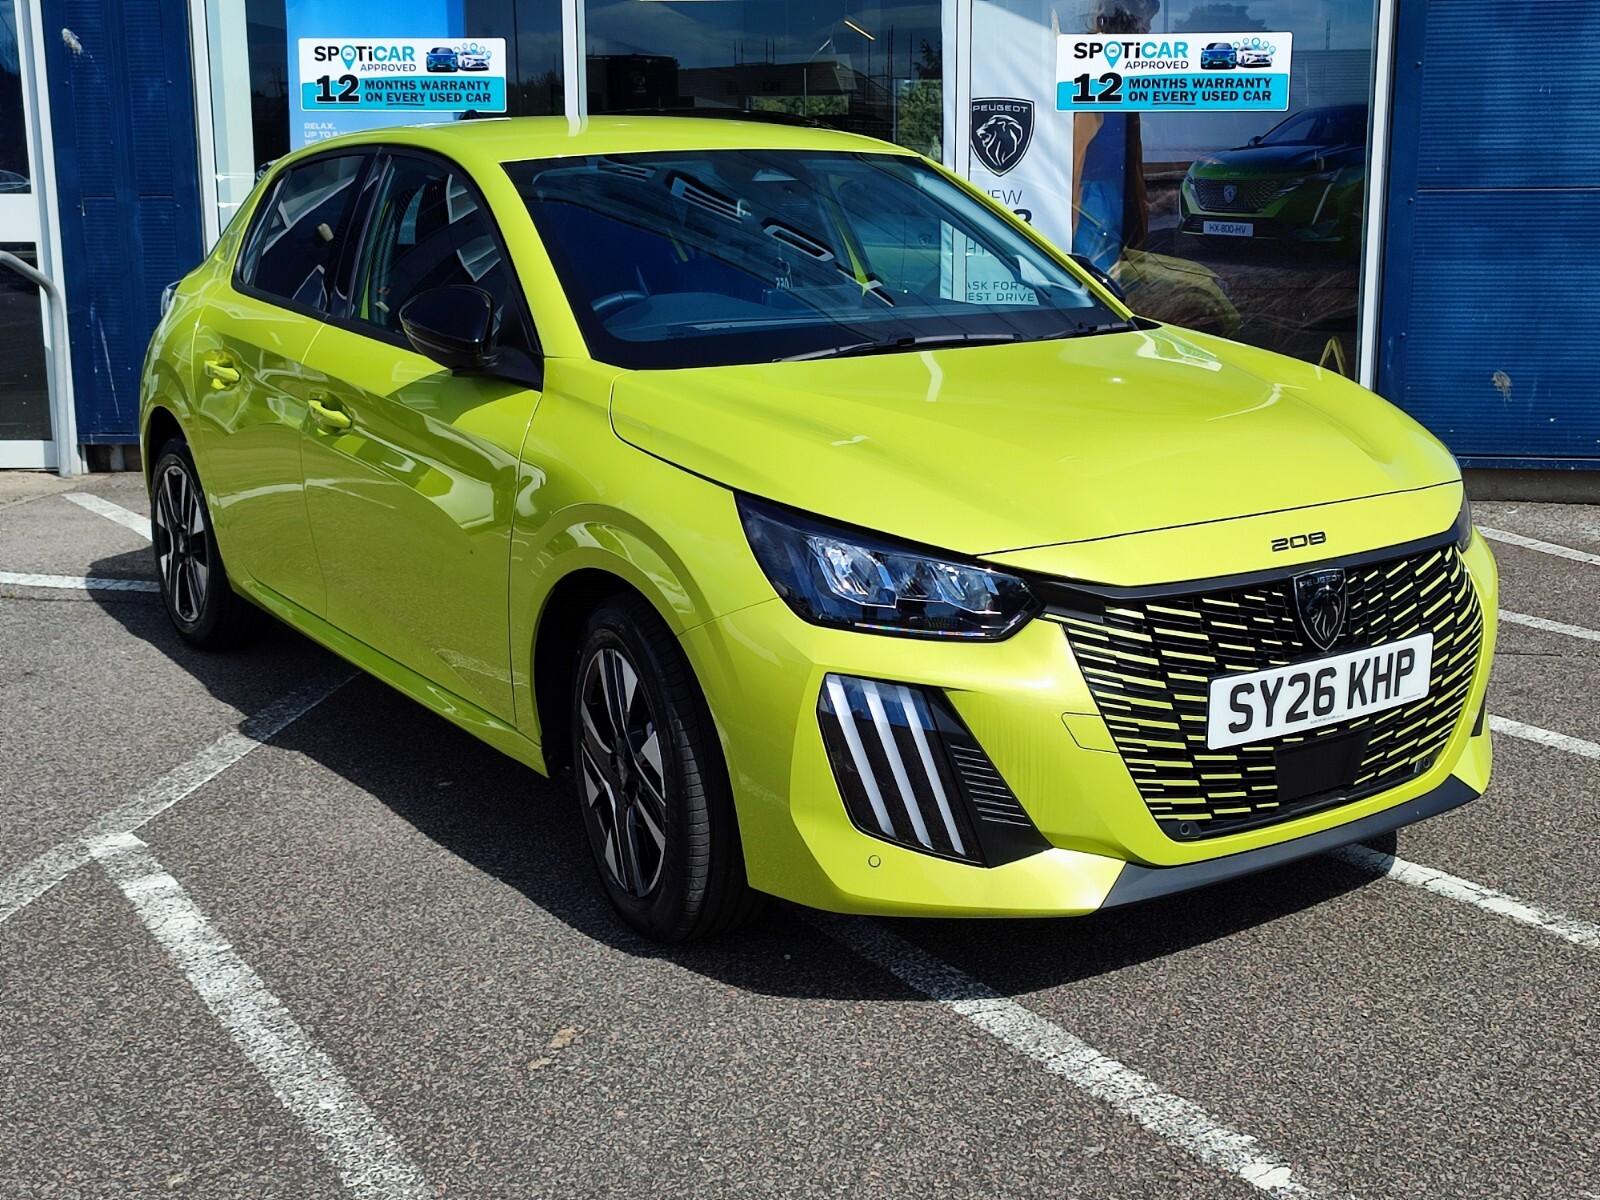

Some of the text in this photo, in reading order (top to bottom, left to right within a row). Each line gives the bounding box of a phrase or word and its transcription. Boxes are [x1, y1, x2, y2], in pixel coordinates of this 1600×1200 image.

[360, 63, 417, 72] APPROVED
[1124, 60, 1189, 70] APPROVED
[315, 74, 360, 103] 12
[365, 80, 490, 90] MONTHS WARRANTY
[1072, 72, 1123, 103] 12
[1128, 78, 1272, 89] MONTHS WARRANTY
[365, 92, 491, 103] ON EVERY USED CAR
[1128, 90, 1272, 102] ON EVERY USED CAR
[972, 104, 1028, 113] PEUGEOT
[304, 122, 336, 130] RELAX.
[987, 189, 1022, 205] EW
[1209, 224, 1247, 234] HX-800-HV
[993, 281, 1018, 290] FOR
[968, 292, 1035, 302] EST DRIVE
[1271, 531, 1326, 552] 208
[1298, 574, 1341, 588] PEUGEOT
[1228, 648, 1415, 734] SY26 KHP
